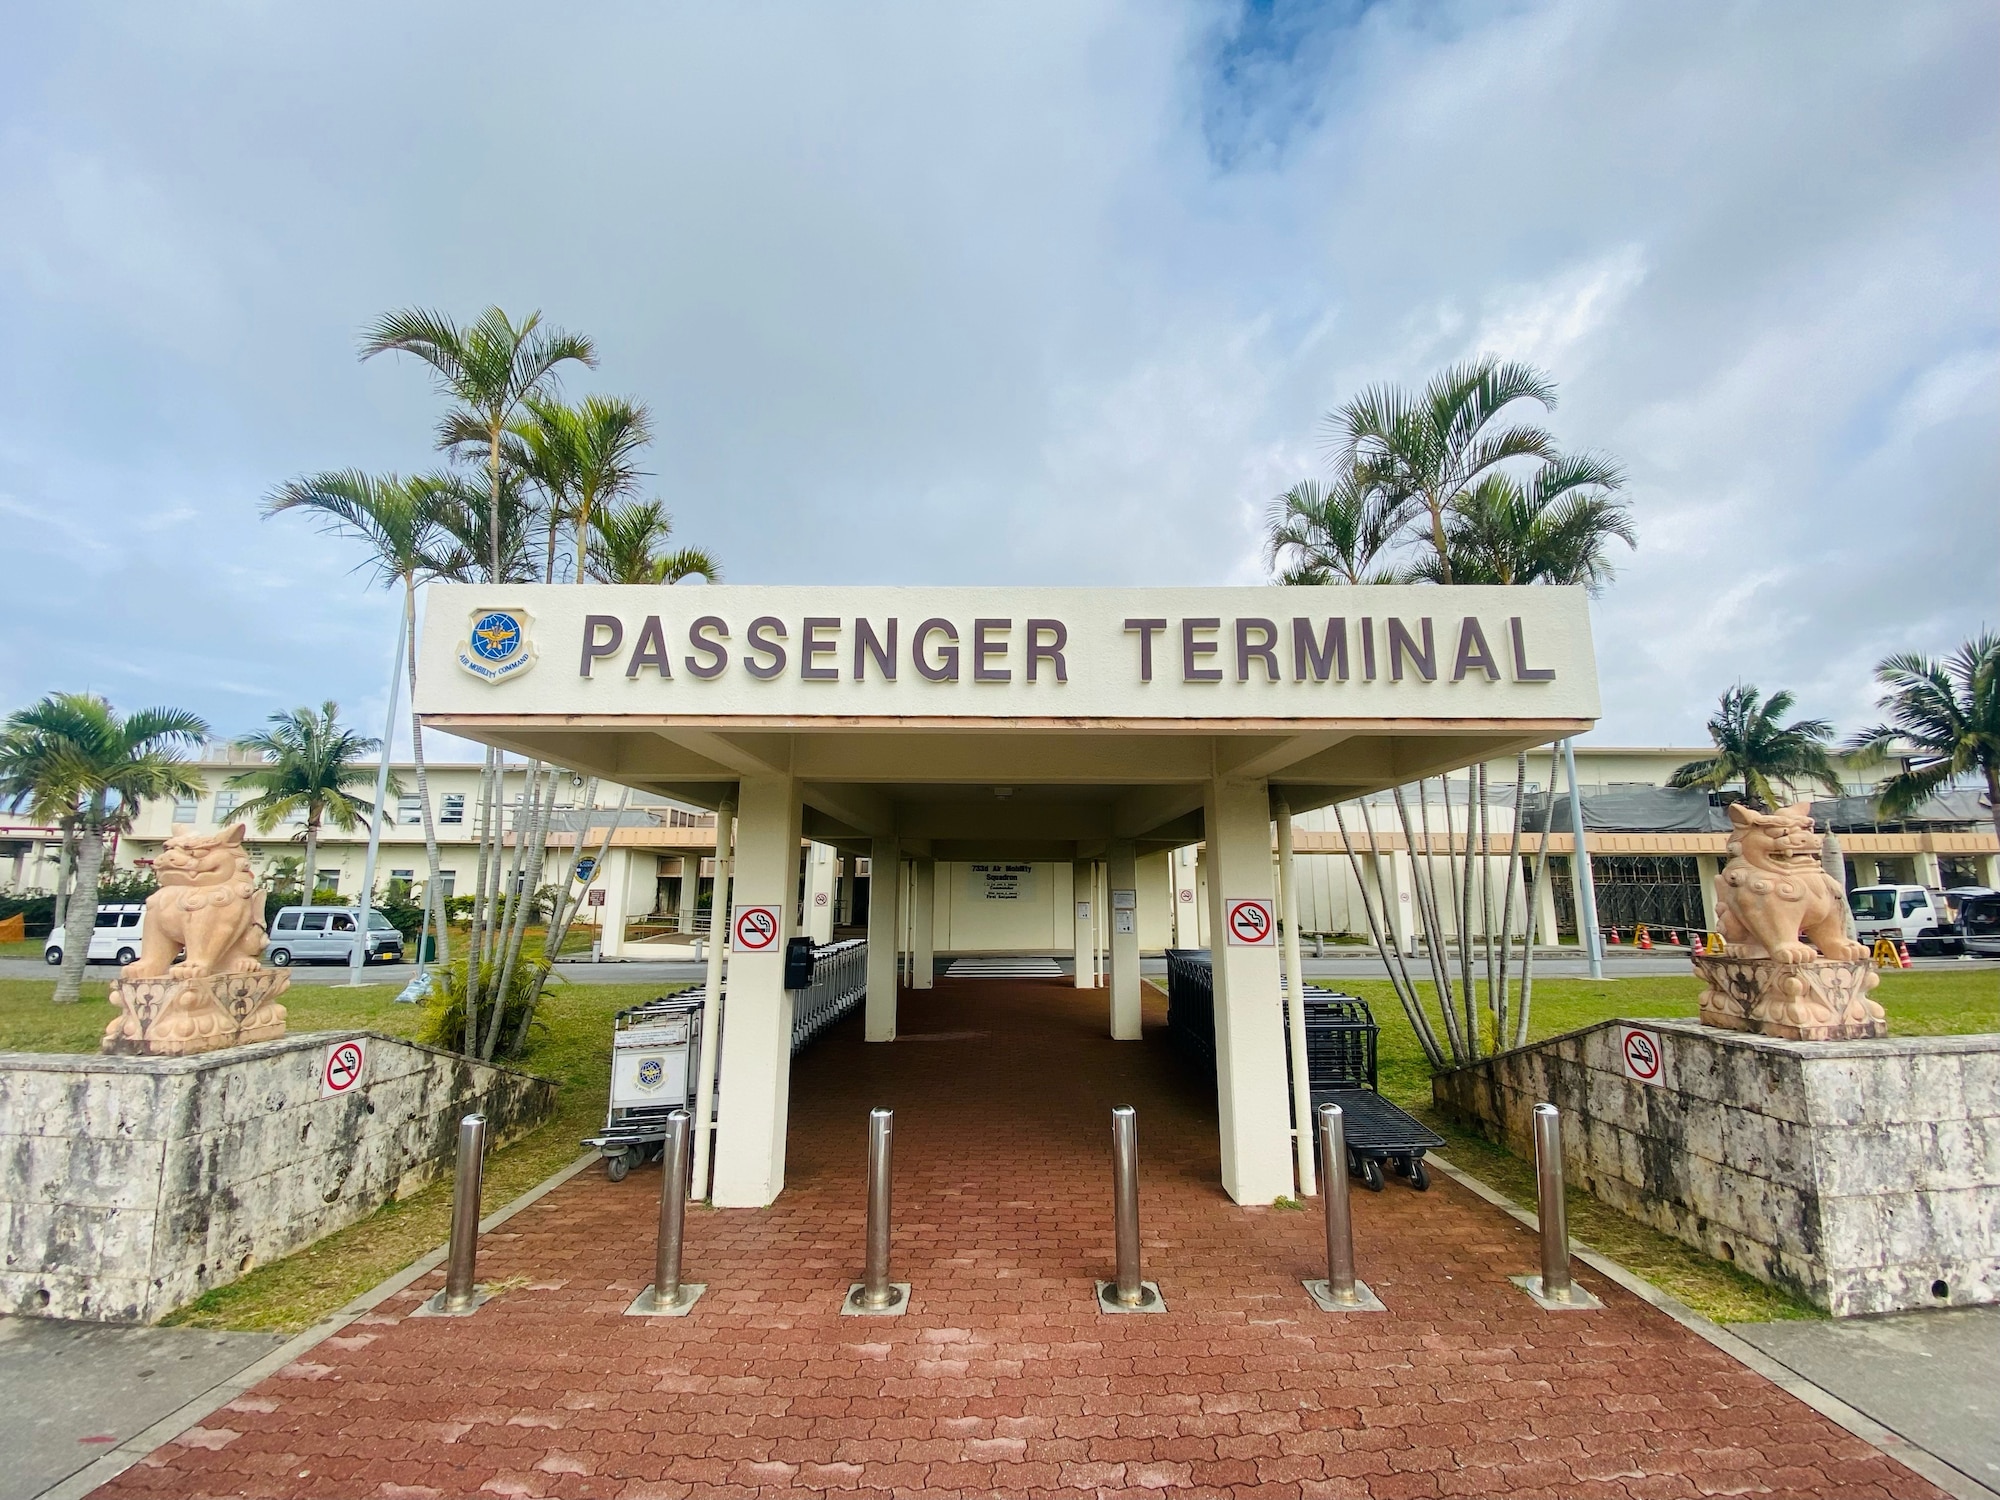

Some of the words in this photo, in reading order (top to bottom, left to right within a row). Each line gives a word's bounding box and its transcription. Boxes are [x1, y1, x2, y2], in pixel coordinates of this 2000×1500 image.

[579, 614, 1068, 682] PASSENGER
[1123, 616, 1556, 682] TERMINAL
[459, 654, 470, 666] AIR
[468, 662, 497, 678] MOBILITY
[498, 653, 529, 675] COMMAND
[1005, 865, 1032, 873] Mobility
